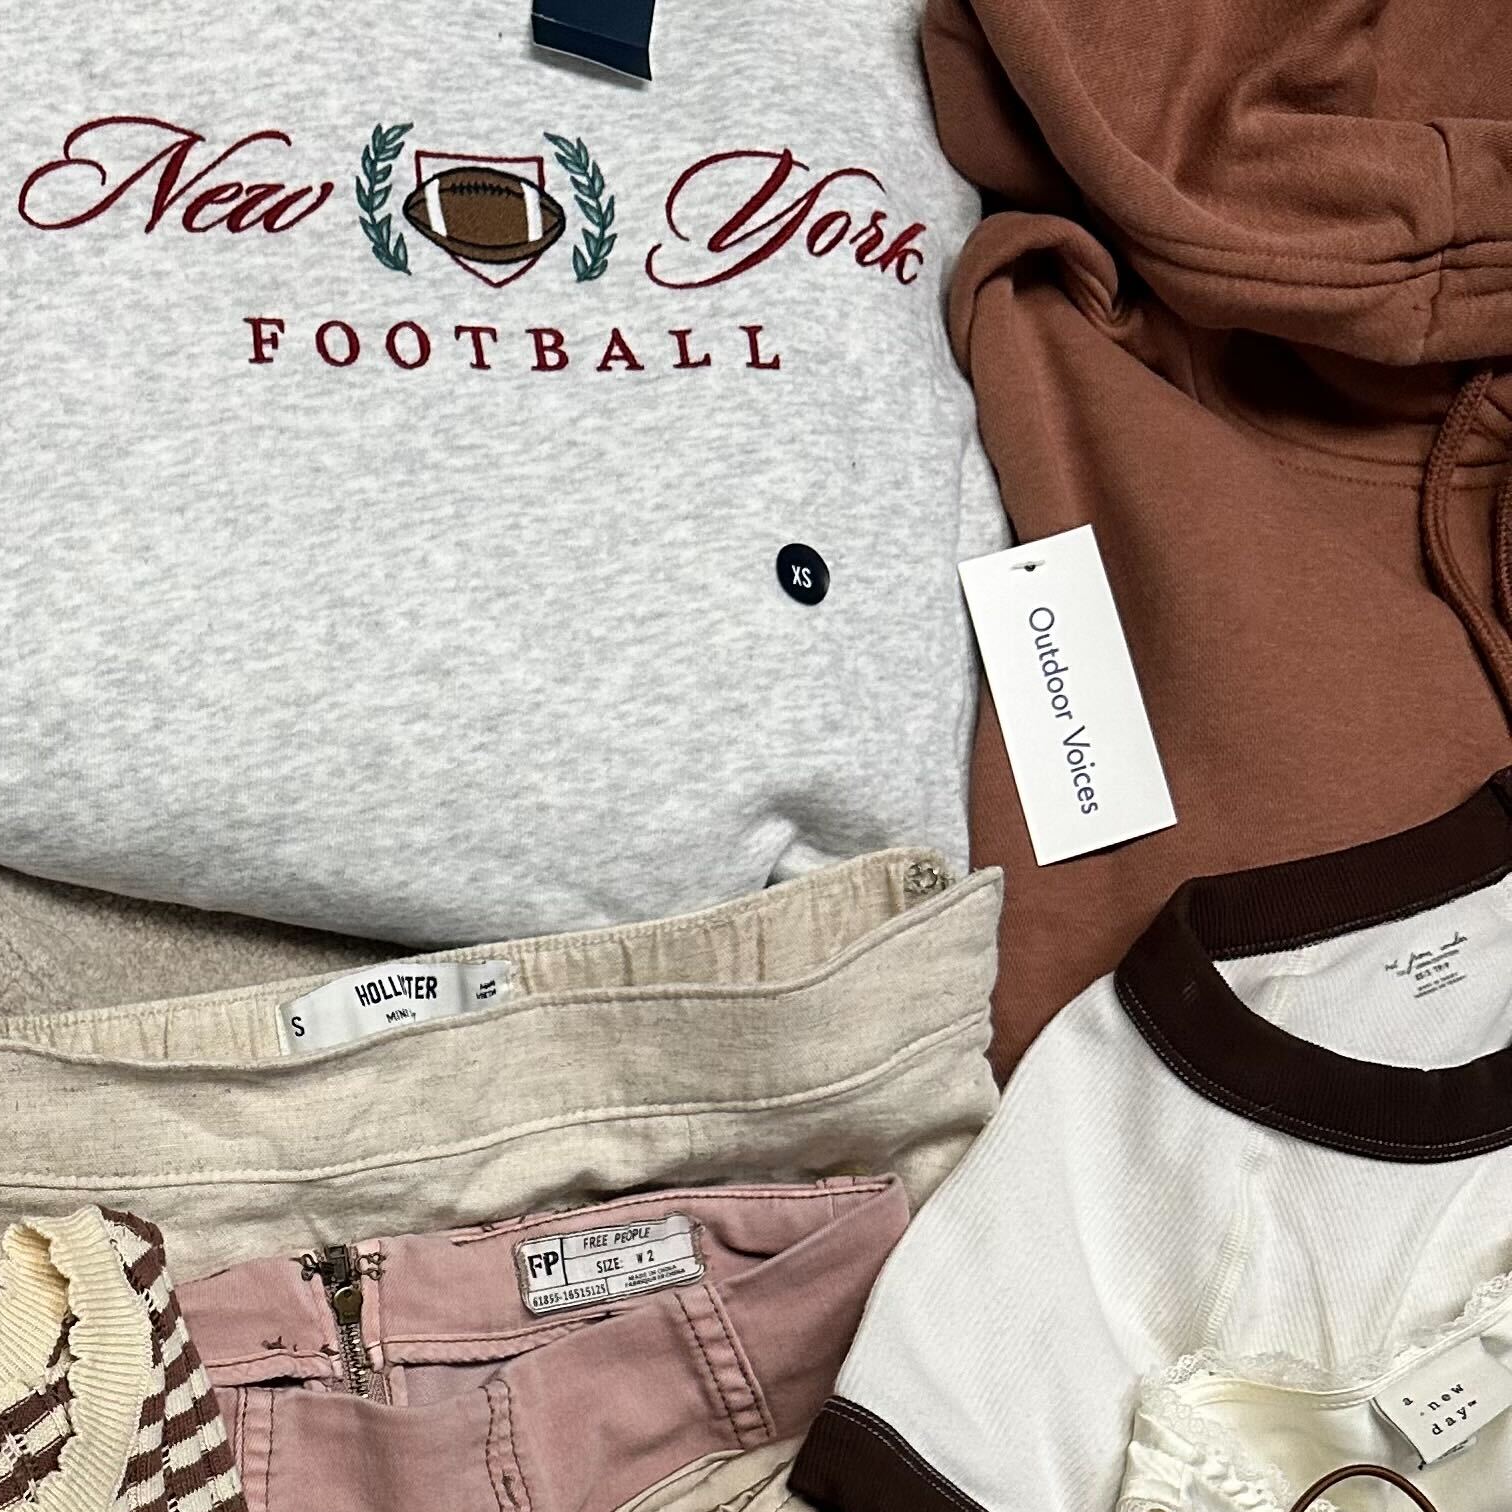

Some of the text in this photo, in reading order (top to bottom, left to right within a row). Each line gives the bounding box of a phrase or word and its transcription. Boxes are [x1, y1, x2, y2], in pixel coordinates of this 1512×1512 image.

[17, 115, 925, 290] New York
[243, 316, 782, 373] FOOTBALL
[791, 564, 813, 589] XS
[1028, 606, 1099, 815] Outdoor Voices
[291, 1016, 306, 1037] S
[583, 1227, 651, 1250] FREE PEOPLE
[527, 1250, 560, 1279] FP
[647, 1249, 655, 1262] 2
[1402, 1397, 1414, 1406] a
[1427, 1384, 1464, 1411] new
